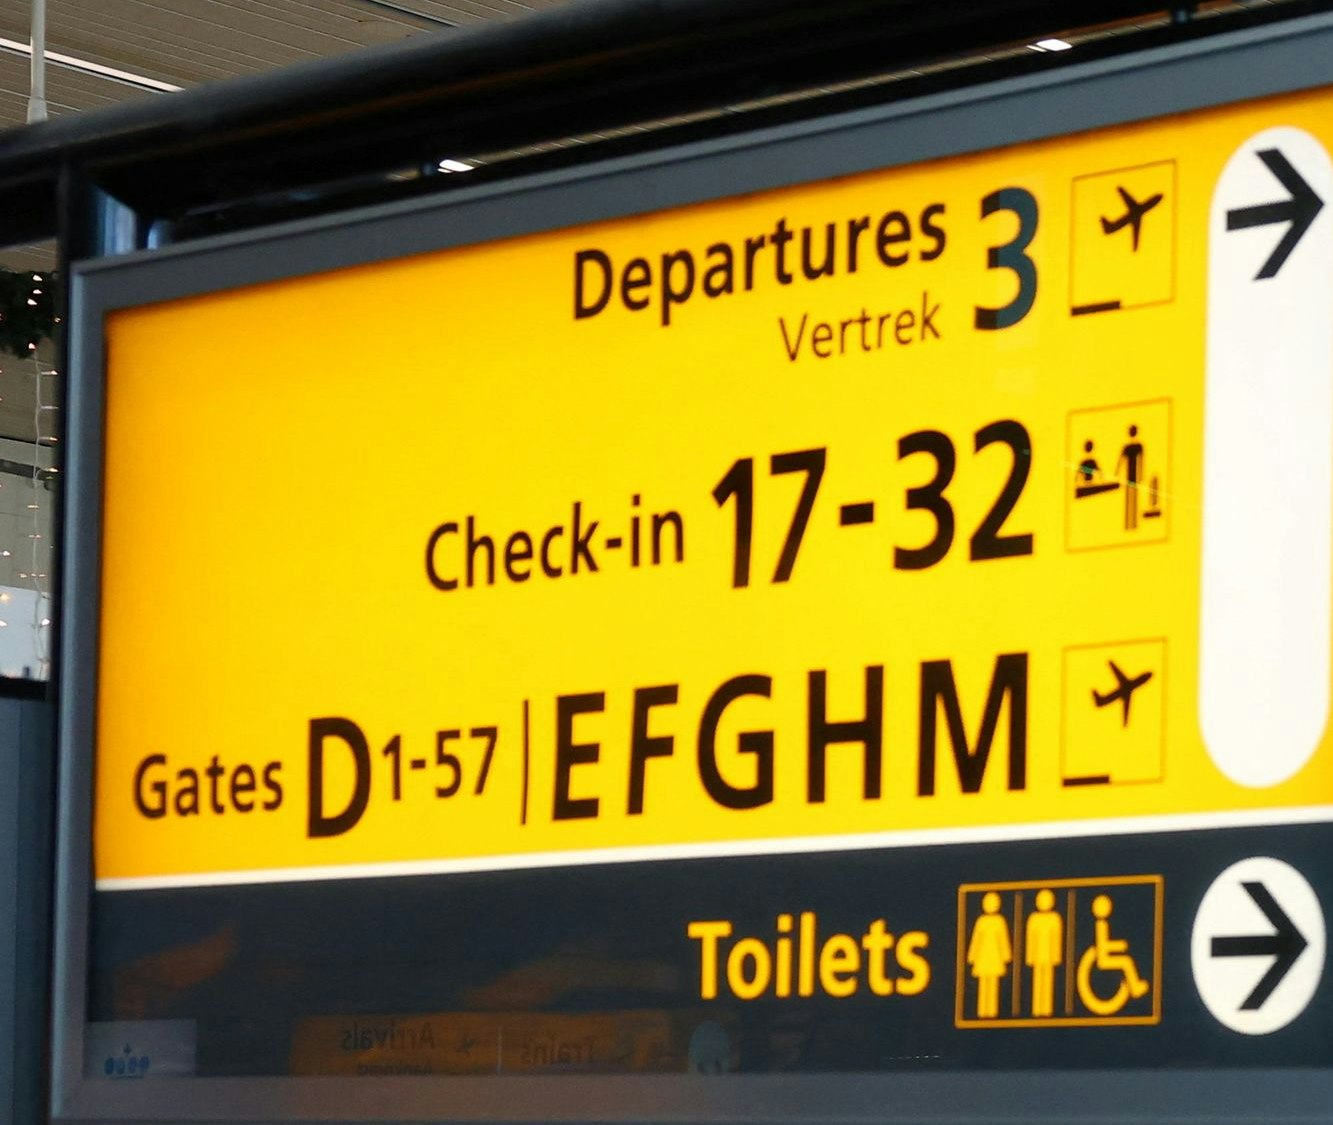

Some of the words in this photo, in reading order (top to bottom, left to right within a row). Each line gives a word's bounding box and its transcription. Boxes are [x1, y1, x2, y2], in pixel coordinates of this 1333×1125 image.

[573, 200, 947, 327] Departures
[974, 184, 1041, 332] 3
[779, 291, 941, 362] Vertrek
[426, 493, 684, 592] Check-in
[711, 417, 1034, 591] 17-32
[134, 752, 283, 819] Gates
[688, 911, 930, 1000] Toilets
